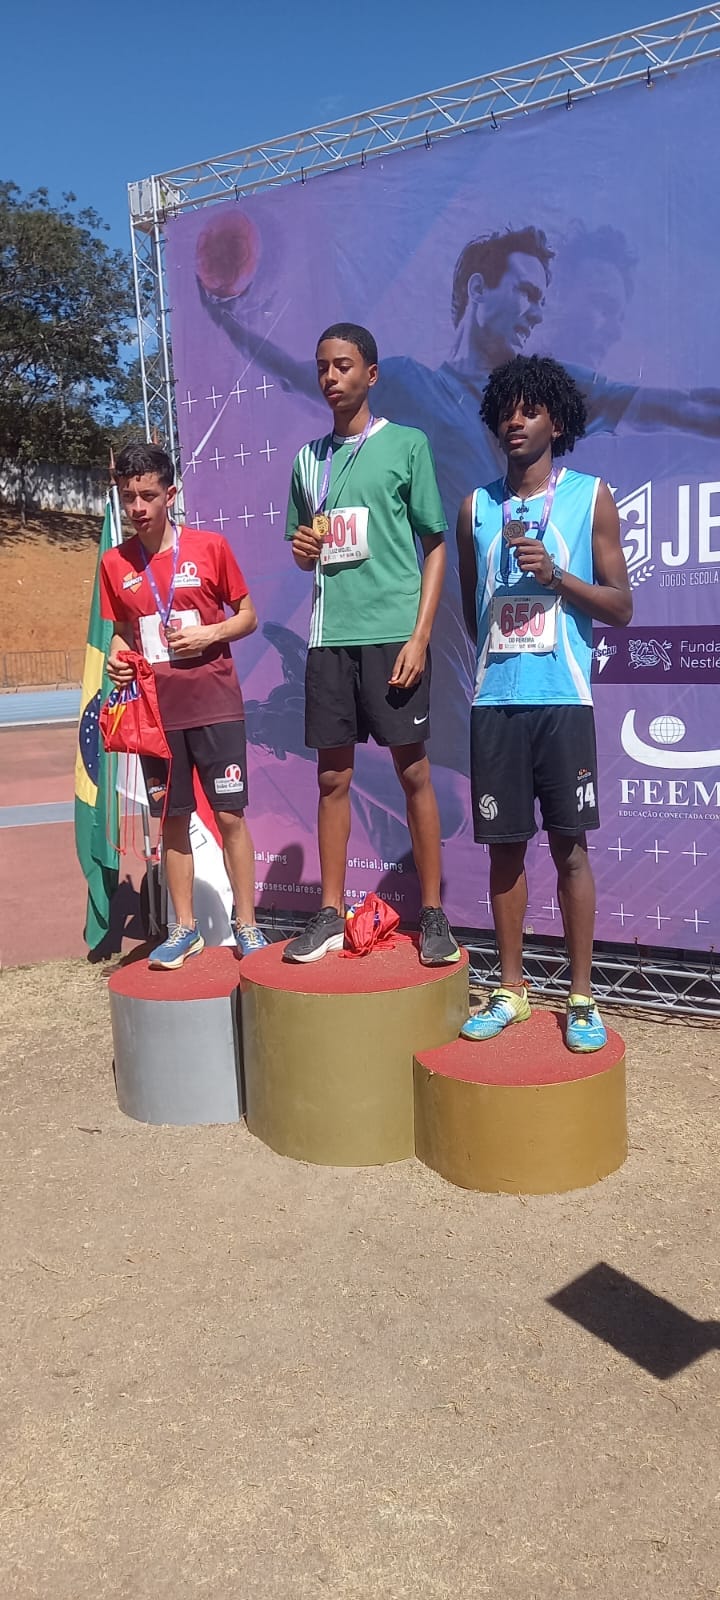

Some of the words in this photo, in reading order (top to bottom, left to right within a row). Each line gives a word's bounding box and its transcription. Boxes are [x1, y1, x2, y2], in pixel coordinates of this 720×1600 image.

[661, 481, 720, 567] JE
[660, 572, 686, 587] JOGOS
[690, 570, 719, 586] ESCOLA
[501, 602, 546, 637] 650
[576, 782, 596, 812] 34
[618, 779, 720, 807] FEEM
[618, 810, 658, 818] EDUCAÇÃO
[659, 812, 704, 820] CONECTADA
[348, 858, 403, 873] oficial.jemg
